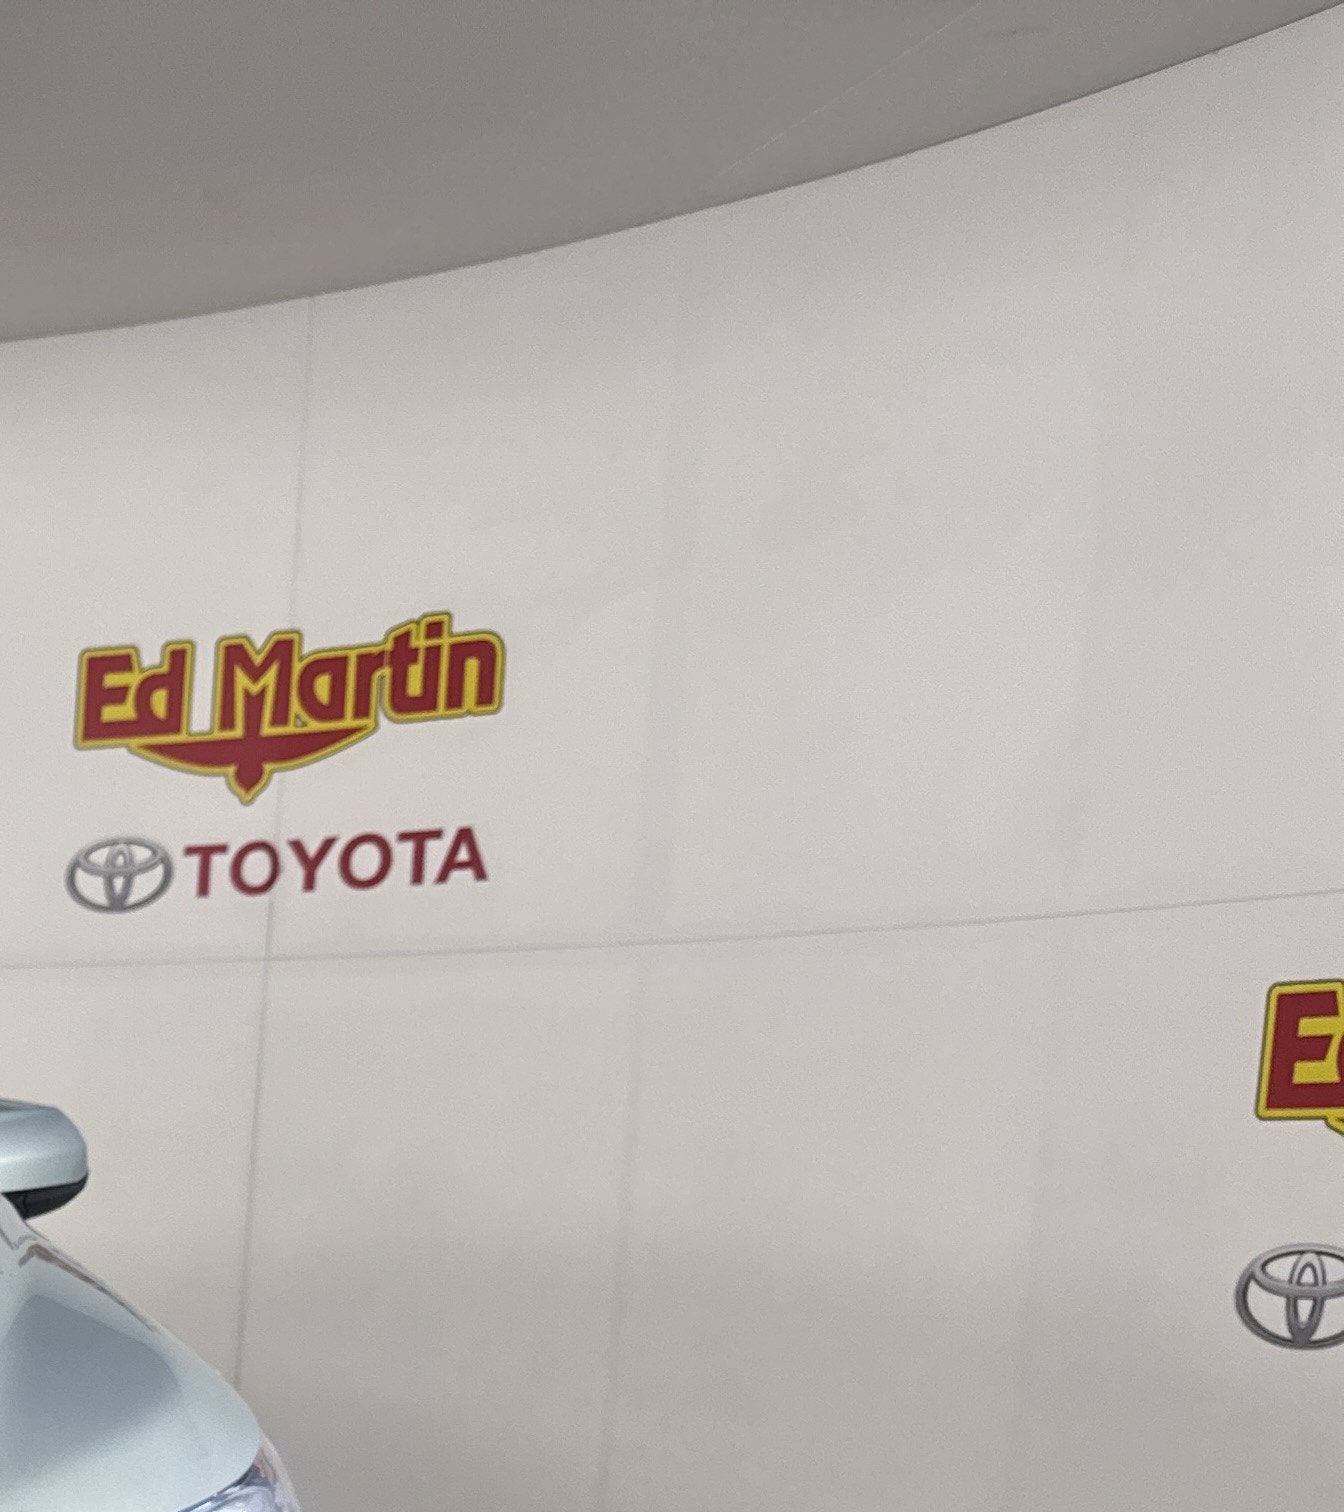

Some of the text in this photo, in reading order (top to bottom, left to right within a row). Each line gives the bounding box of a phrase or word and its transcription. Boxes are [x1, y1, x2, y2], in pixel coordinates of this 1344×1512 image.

[78, 617, 503, 745] Ed Martin
[183, 825, 489, 899] TOYOTA
[1261, 986, 1344, 1114] E
